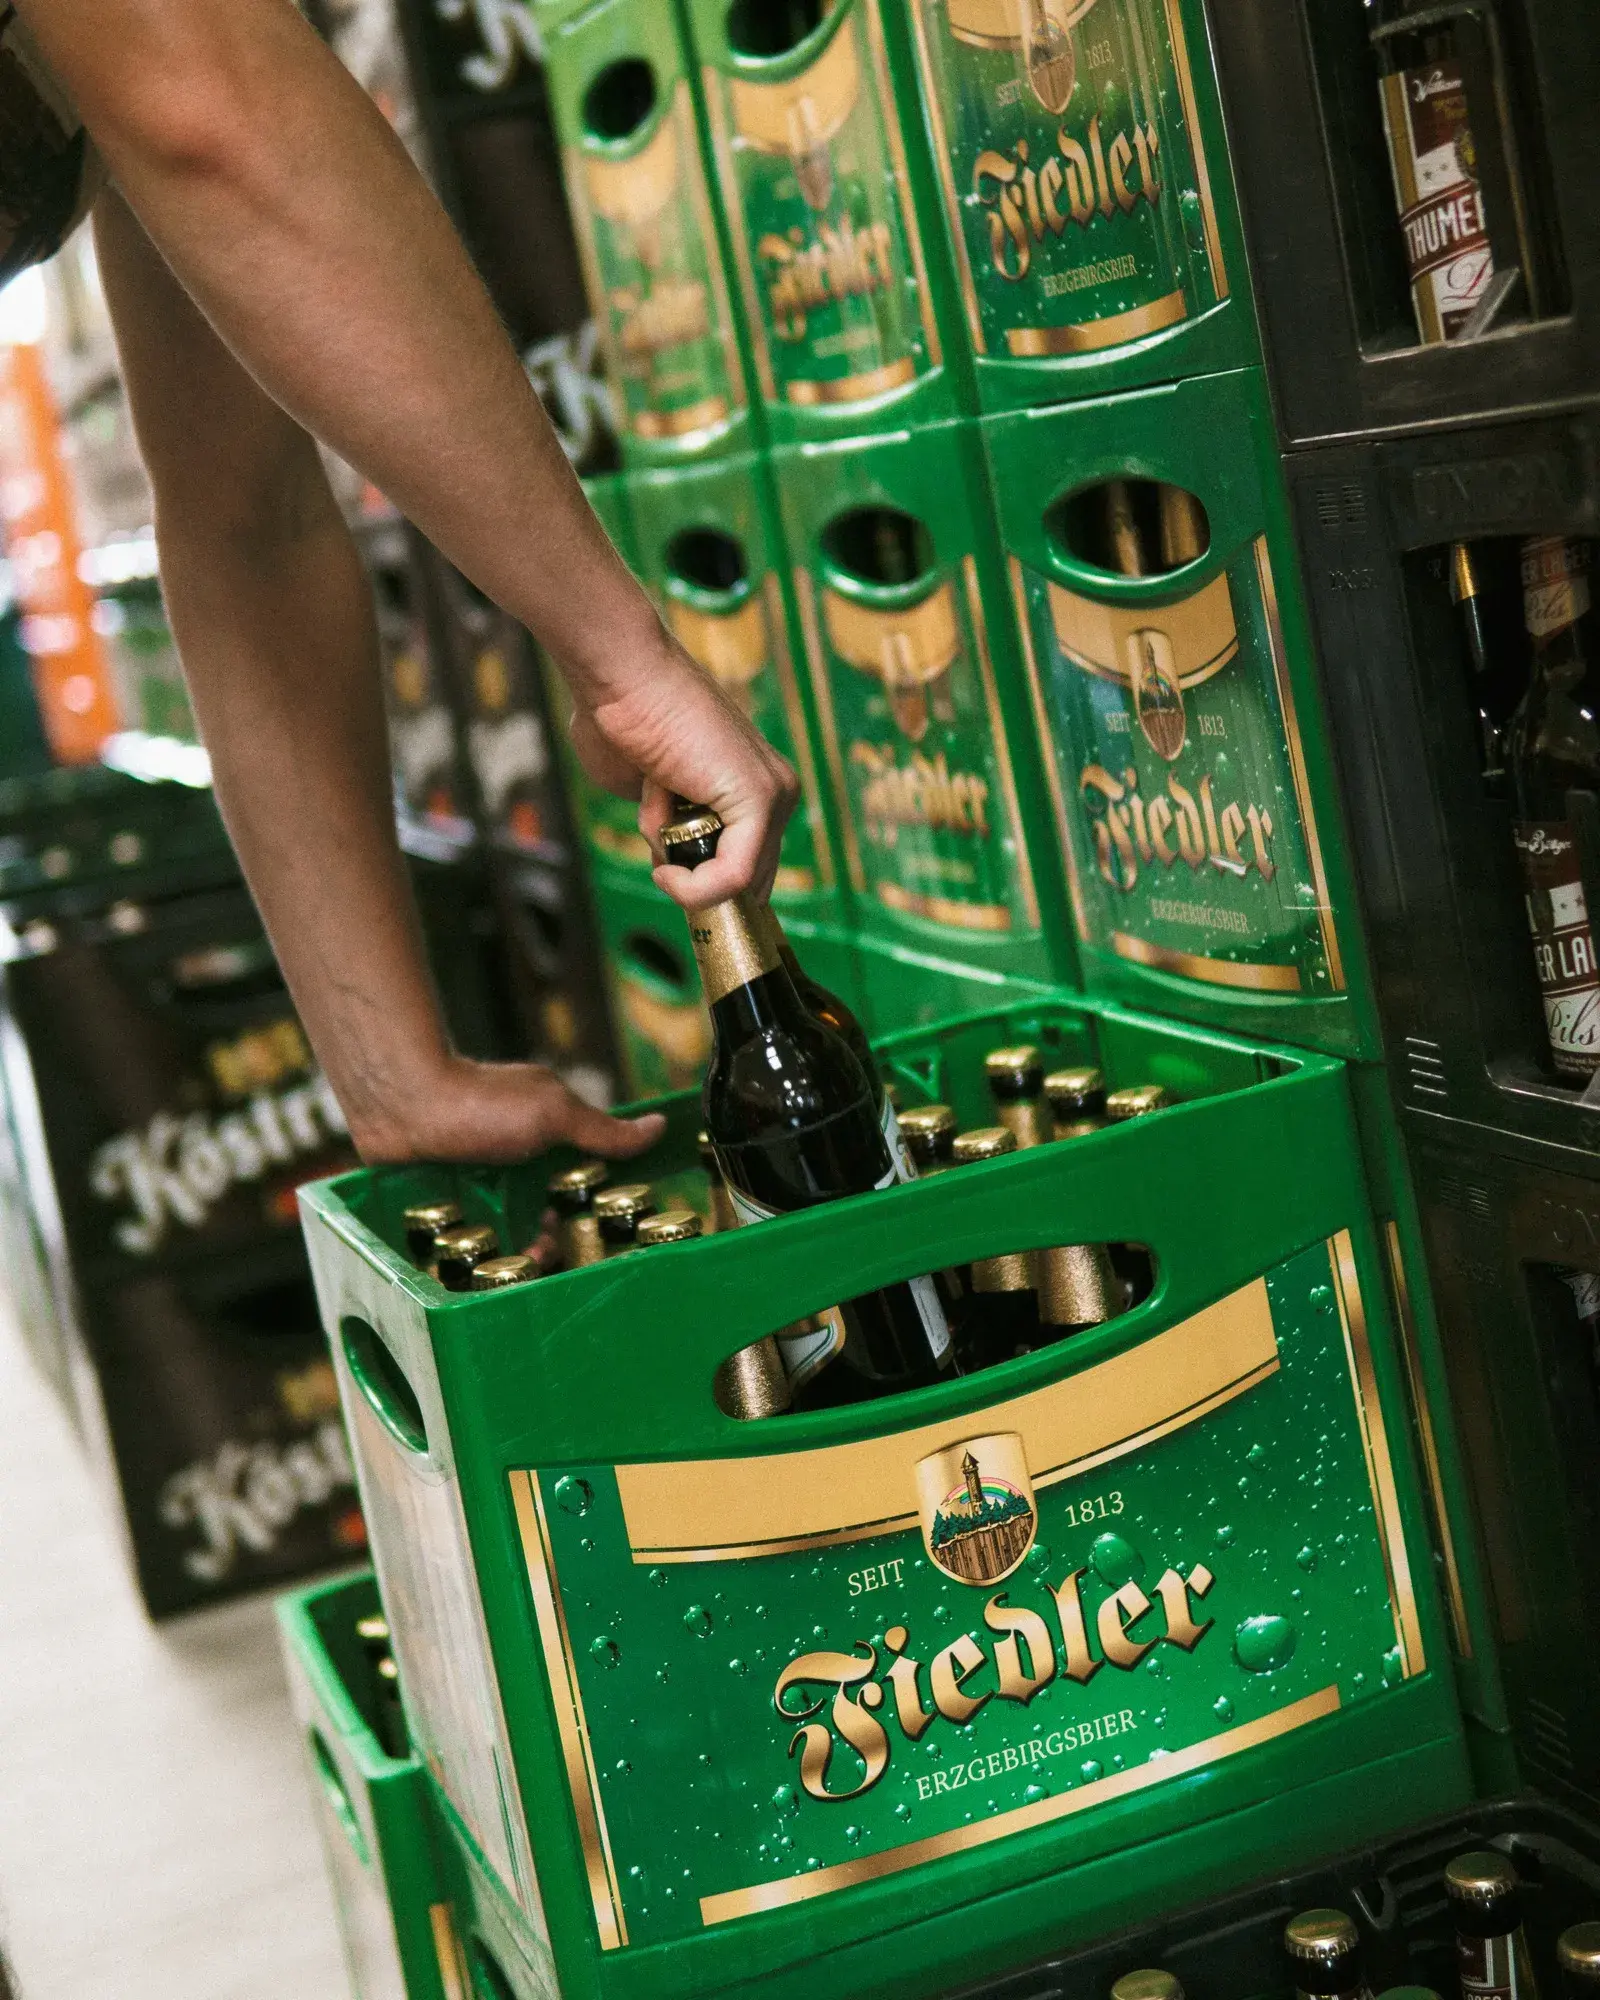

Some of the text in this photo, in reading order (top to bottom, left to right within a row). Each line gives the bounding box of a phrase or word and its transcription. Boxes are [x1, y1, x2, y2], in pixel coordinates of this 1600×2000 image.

[1086, 40, 1114, 70] 1813
[973, 112, 1160, 281] Fiedler
[1043, 254, 1138, 297] ERZGEBIRGSBIER
[1197, 715, 1225, 736] 1813
[1080, 764, 1275, 892] Fiedler
[846, 1491, 1125, 1597] SEIT 1813
[773, 1562, 1215, 1802] Fiedler
[915, 1708, 1138, 1801] ERZGEBIRGSBIER
